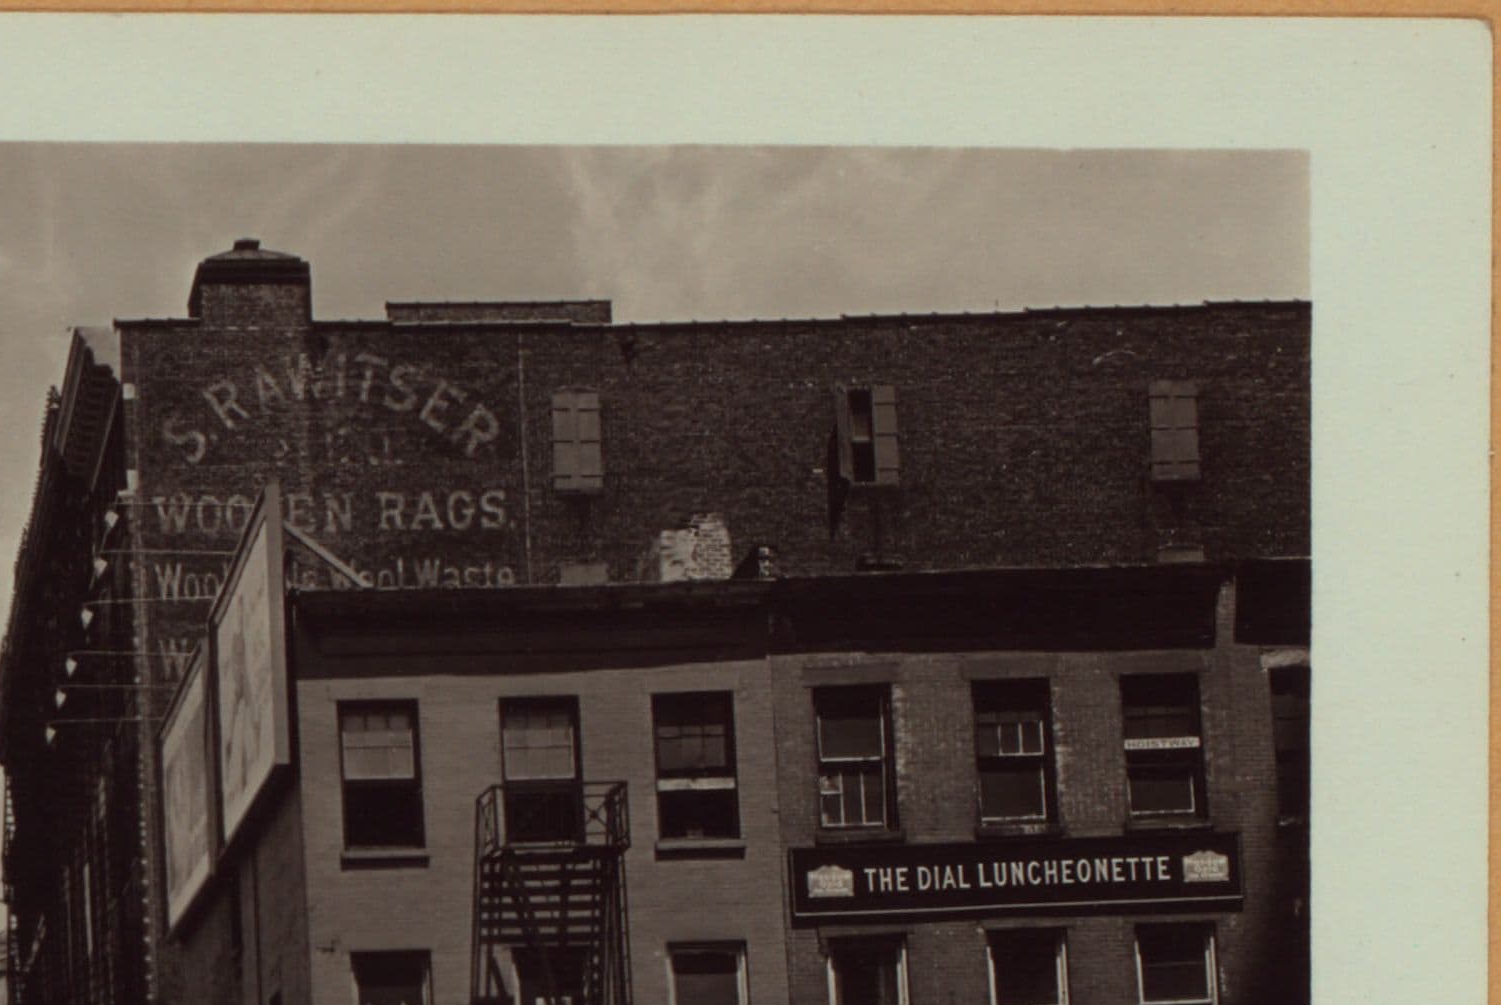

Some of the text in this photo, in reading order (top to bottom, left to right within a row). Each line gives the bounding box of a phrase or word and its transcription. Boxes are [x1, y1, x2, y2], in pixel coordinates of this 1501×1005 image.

[155, 492, 355, 534] WOOEN
[413, 558, 515, 590] Waste
[864, 866, 909, 893] THE
[917, 863, 970, 891] DIAL
[978, 855, 1171, 888] LUNCHEONETTE
